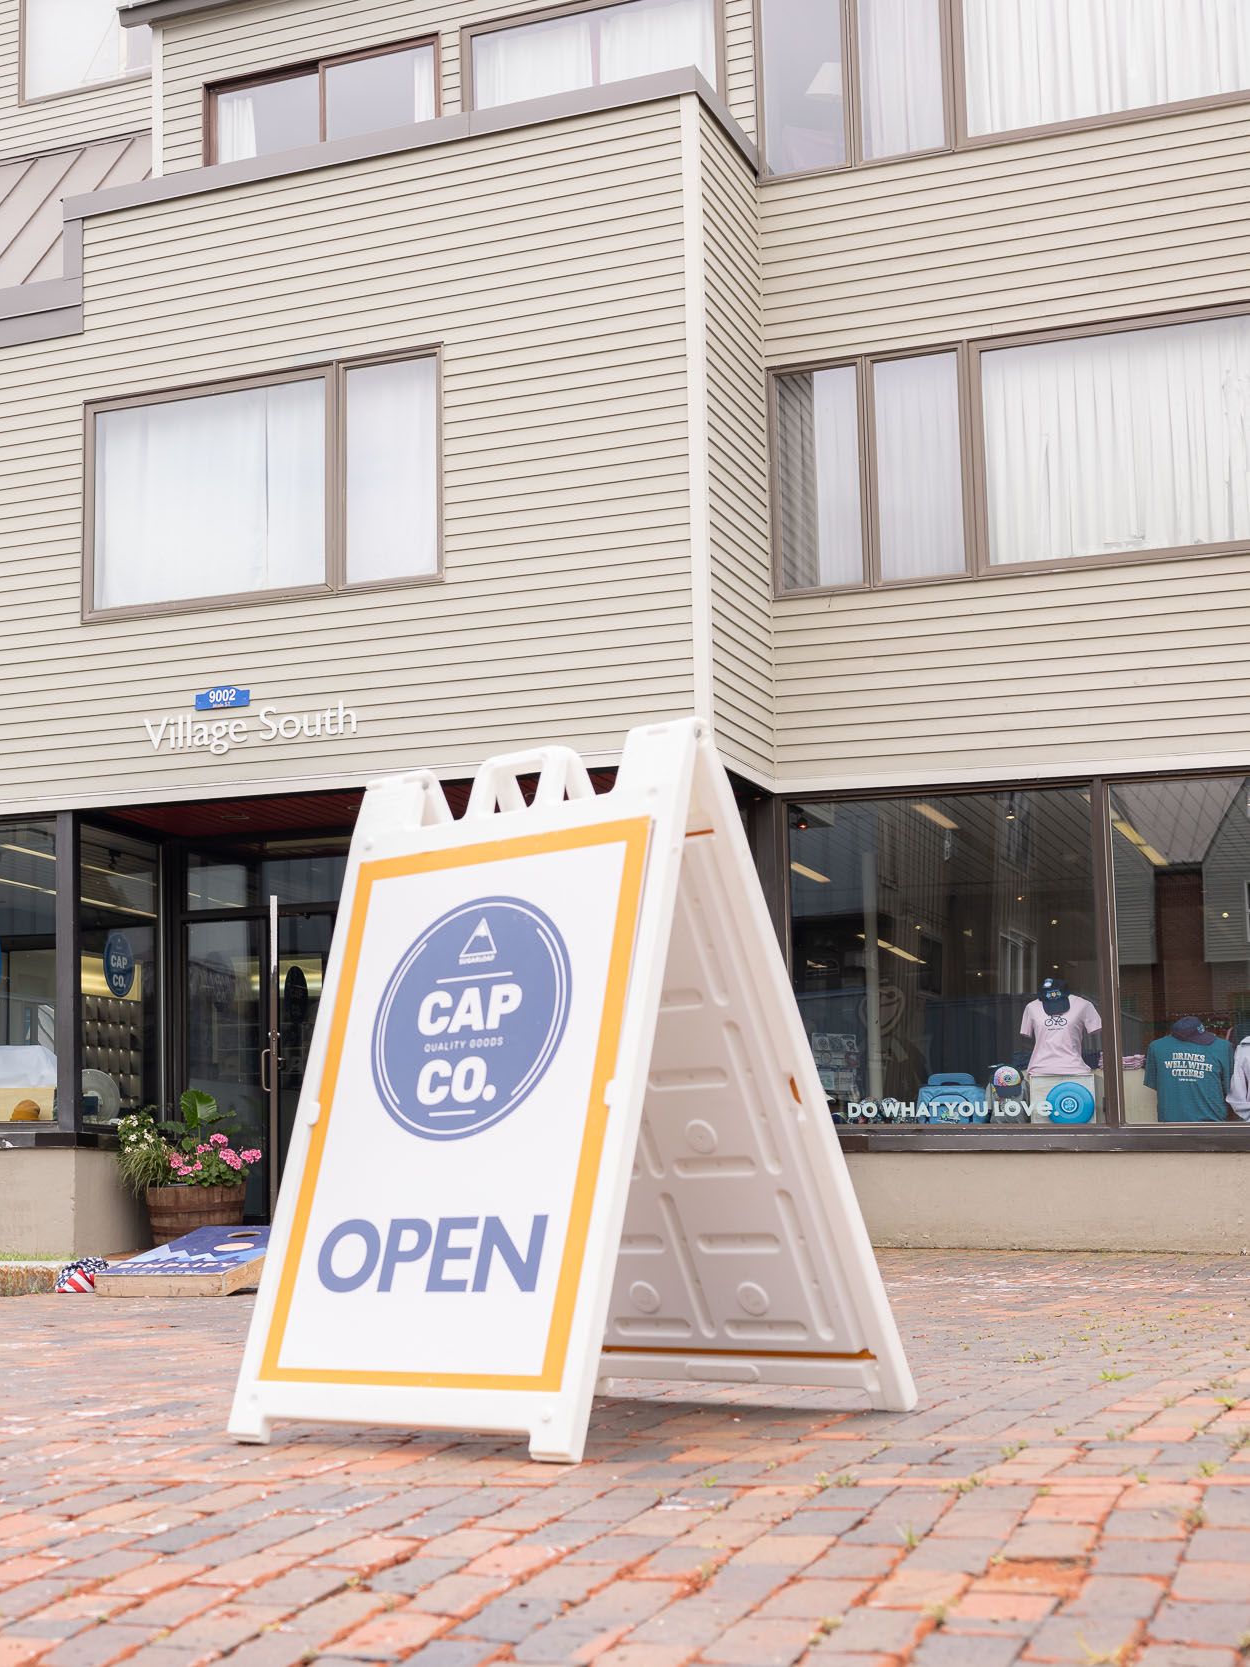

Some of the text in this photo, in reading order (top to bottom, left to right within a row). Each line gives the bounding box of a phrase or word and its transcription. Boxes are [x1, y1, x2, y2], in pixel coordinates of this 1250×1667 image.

[209, 689, 236, 703] 9002
[143, 699, 357, 755] Village South
[111, 954, 127, 969] CAP
[417, 983, 523, 1036] CAP
[424, 1036, 504, 1053] QUALITY GOODS
[1172, 1052, 1205, 1063] DRINKS
[1164, 1061, 1213, 1072] WELL WITH
[1171, 1068, 1205, 1079] OTHERS
[416, 1056, 497, 1106] CO.
[847, 1102, 878, 1118] DO
[881, 1101, 941, 1118] WHAT
[943, 1101, 989, 1117] YOU
[317, 1214, 549, 1293] OPEN
